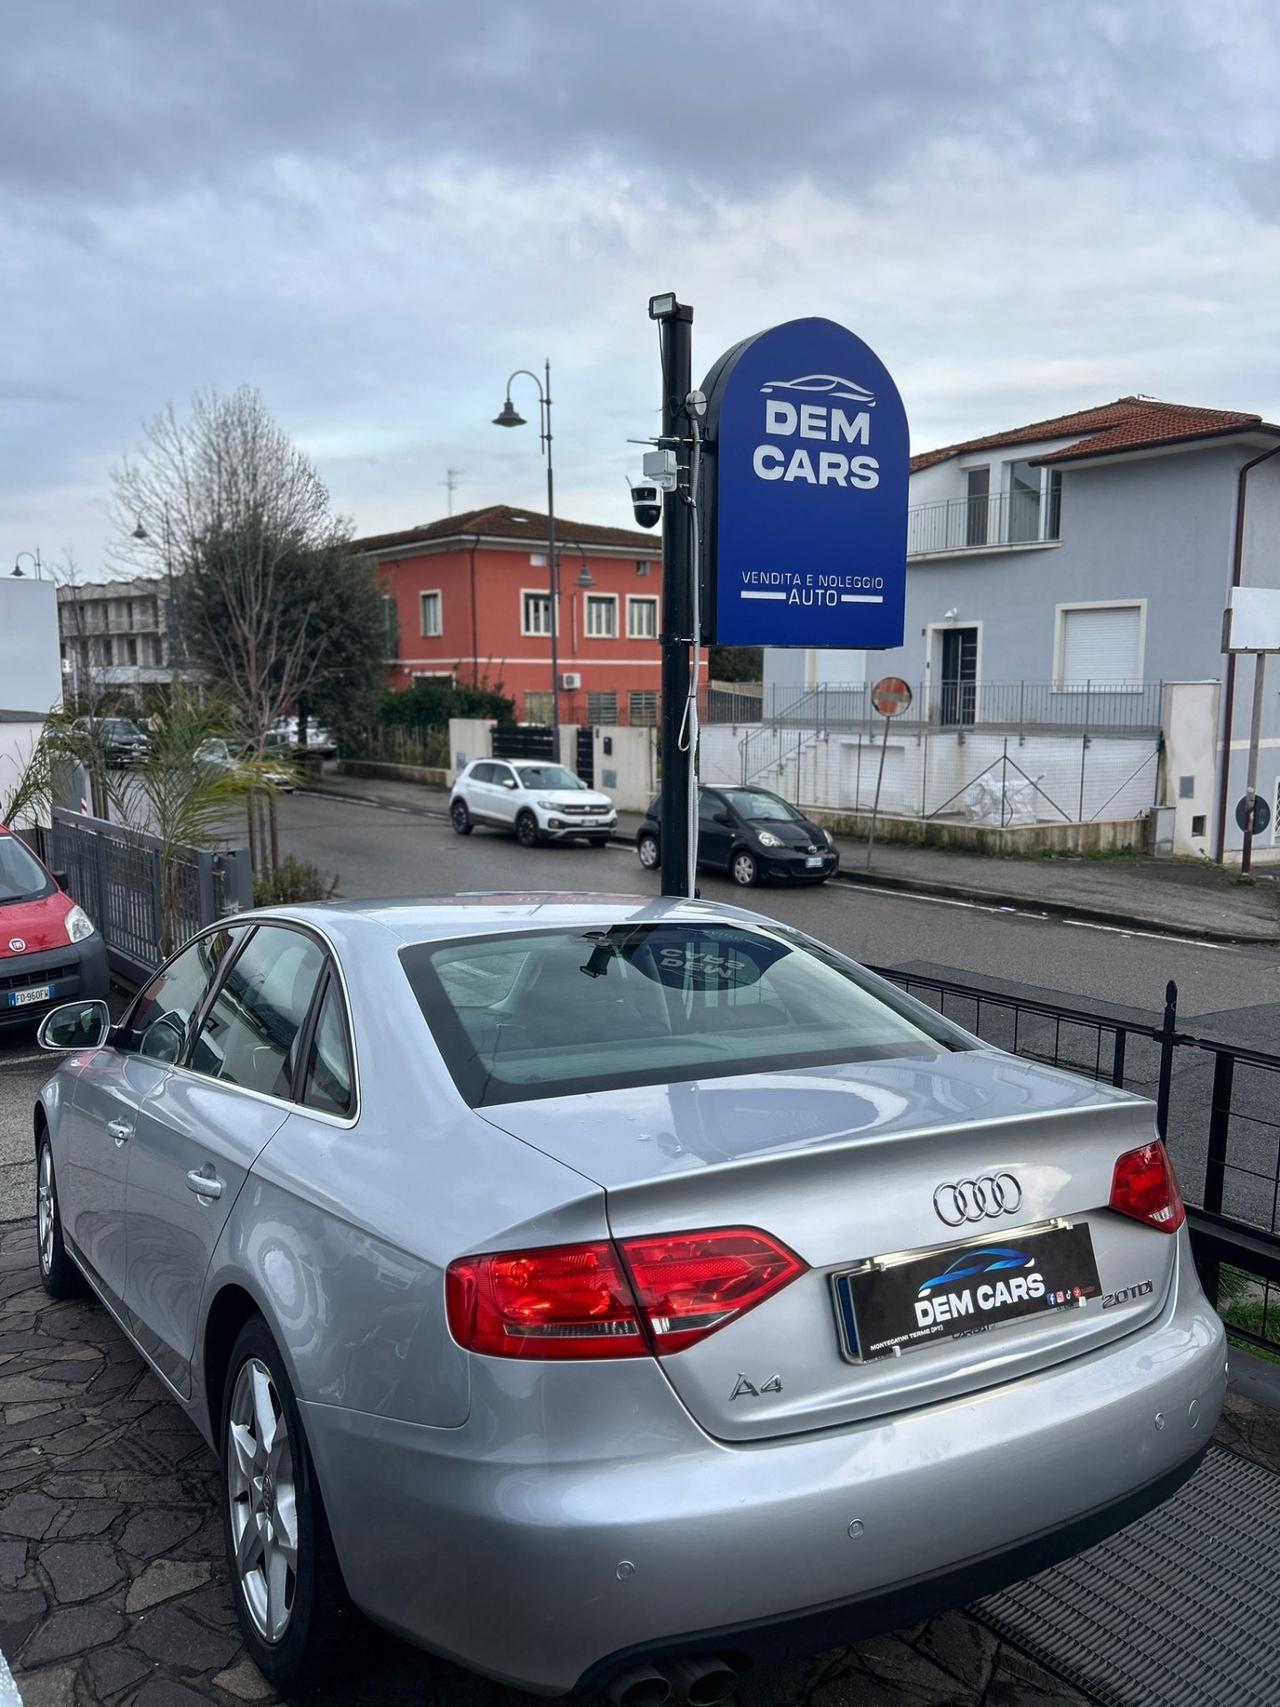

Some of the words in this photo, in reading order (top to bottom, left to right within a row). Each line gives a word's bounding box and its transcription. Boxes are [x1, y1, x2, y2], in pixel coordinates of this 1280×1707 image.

[766, 399, 870, 445] DEM
[753, 445, 880, 489] CARS
[742, 571, 801, 586] VENDITA
[806, 574, 813, 586] E
[818, 574, 884, 590] NOLEGGIO
[788, 589, 838, 606] AUTO
[914, 1291, 974, 1328] DEM
[977, 1273, 1046, 1310] CARS
[870, 1334, 909, 1351] MONTECATINI
[909, 1328, 931, 1340] TERME
[728, 1372, 784, 1402] A4
